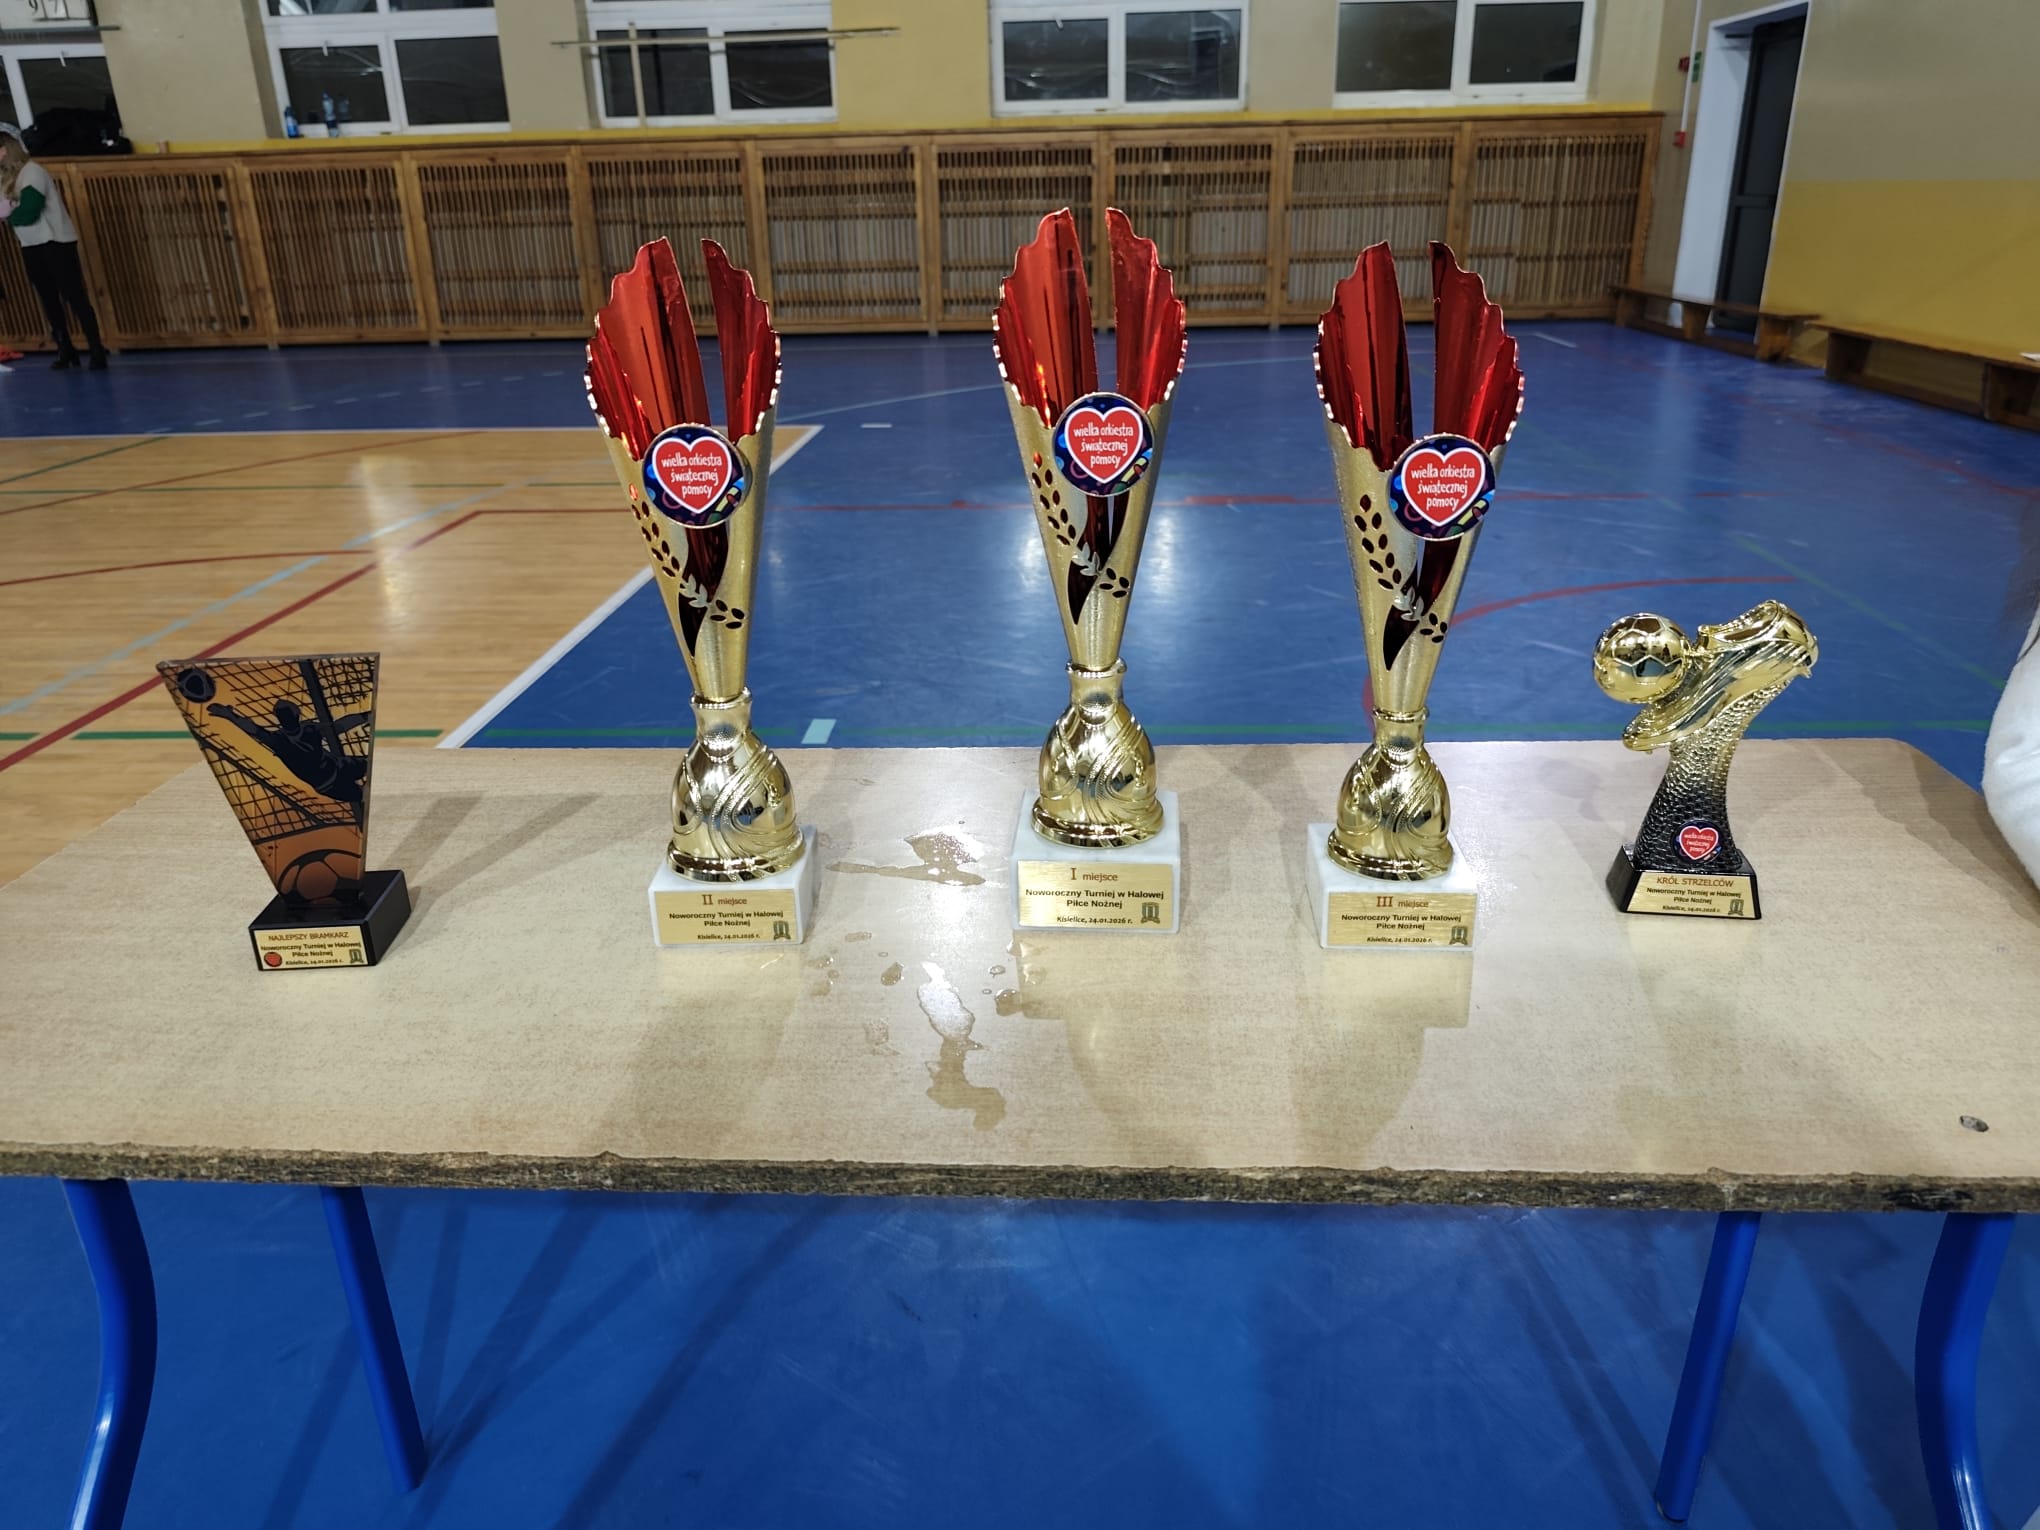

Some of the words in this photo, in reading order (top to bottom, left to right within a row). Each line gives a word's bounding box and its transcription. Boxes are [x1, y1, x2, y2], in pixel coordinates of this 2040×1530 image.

[1074, 422, 1099, 437] wielka
[1101, 422, 1133, 436] orkiestra
[1081, 438, 1128, 456] świątecznej
[662, 452, 687, 467] wielka
[689, 451, 722, 466] orkiestra
[1090, 455, 1121, 468] pomocy
[671, 468, 718, 486] świątecznej
[1411, 463, 1438, 478] wielka
[1440, 464, 1475, 478] orkiestra
[682, 485, 712, 499] pomocy
[1417, 480, 1468, 499] świątecznej
[1426, 498, 1459, 512] pomocy
[1070, 868, 1076, 880] I
[1082, 872, 1118, 882] miejsce
[1682, 877, 1733, 887] STRZELCÓW
[702, 894, 713, 905] II
[718, 898, 748, 906] miejsce
[1026, 889, 1081, 898] Noworoczny
[1084, 890, 1115, 898] Turniej
[1127, 890, 1164, 899] Halowej
[1092, 900, 1122, 909] Nożnej
[1376, 896, 1393, 907] III
[1398, 900, 1429, 908] miejsce
[725, 919, 750, 927] Nożnej
